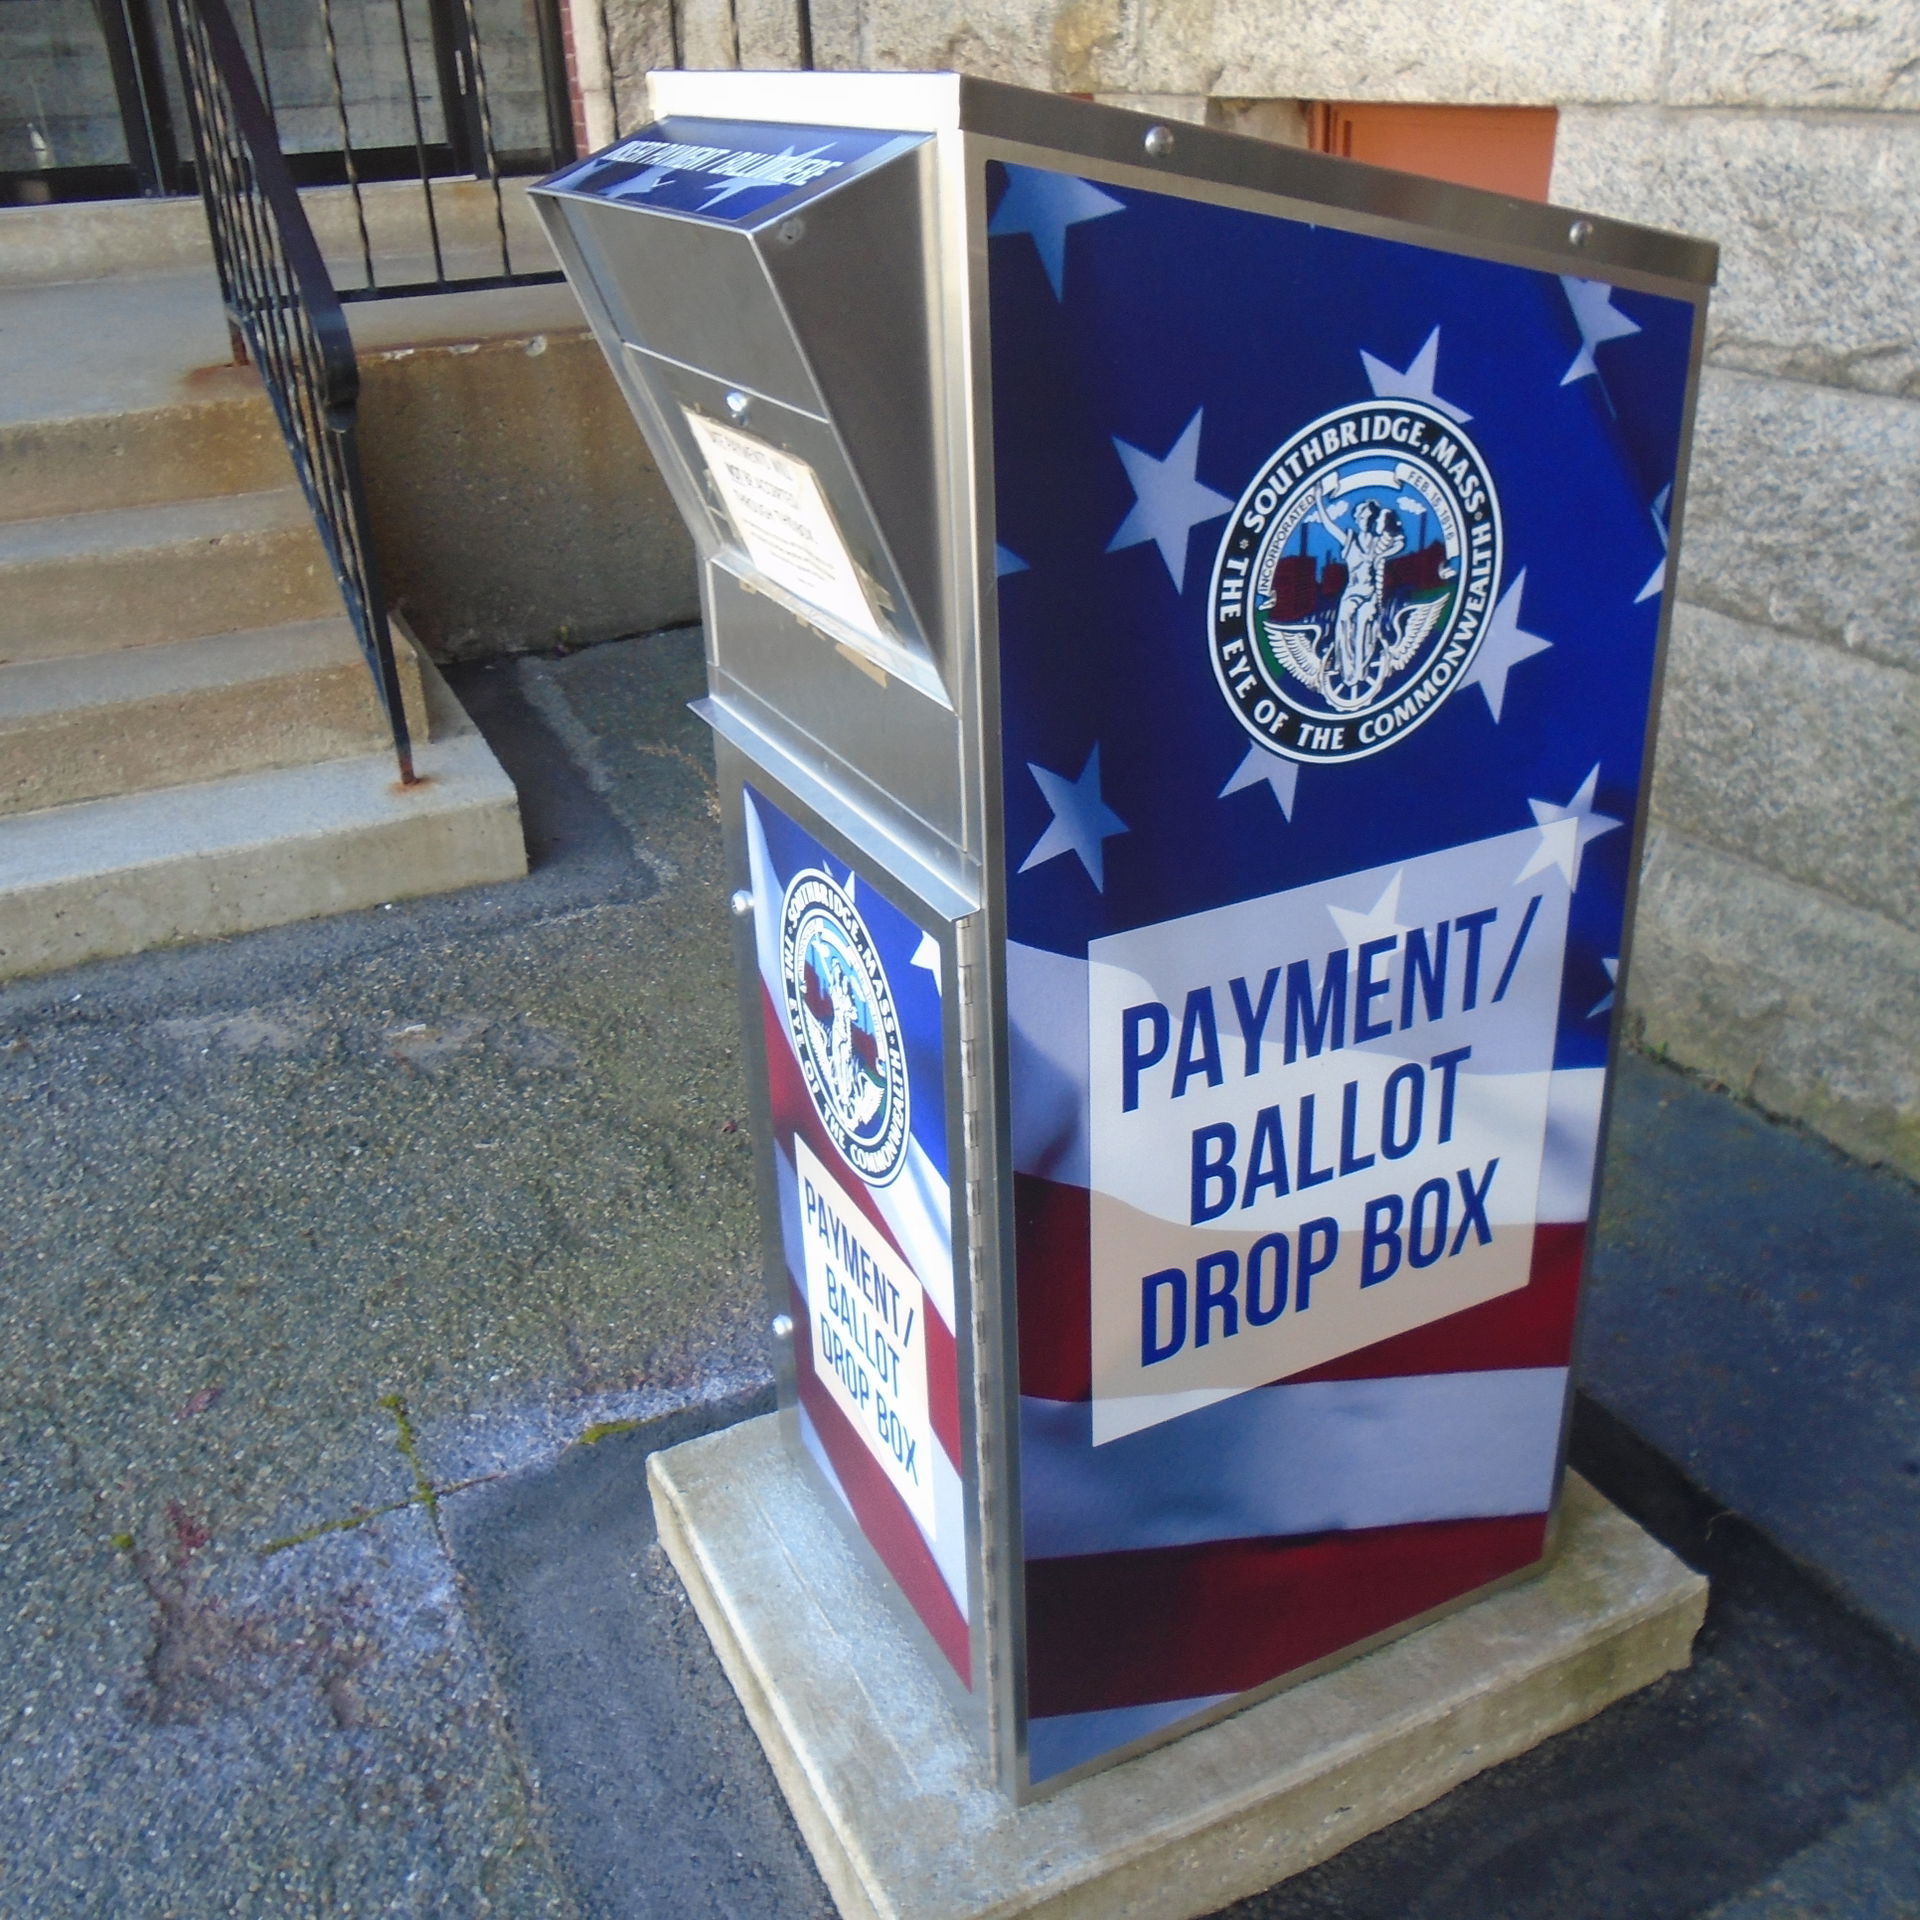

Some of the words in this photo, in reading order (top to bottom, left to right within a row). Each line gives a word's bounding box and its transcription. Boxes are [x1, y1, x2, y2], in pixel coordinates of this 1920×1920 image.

[1431, 436, 1486, 515] MASS
[1219, 557, 1249, 622] THE
[1259, 493, 1316, 592] INCORPORATED
[1222, 638, 1257, 699] EYE
[1357, 521, 1492, 745] COMMONWEALTH
[1254, 699, 1289, 735] OF
[1297, 722, 1346, 750] THE
[1121, 894, 1543, 1113] PAYMENT/
[823, 1103, 846, 1149] THE
[1190, 1046, 1471, 1226] BALLOT
[1141, 1216, 1338, 1367] DROP
[1360, 1157, 1500, 1289] BOX
[825, 1262, 900, 1399] BALLOT
[819, 1311, 870, 1410] DROP
[876, 1388, 919, 1487] BOX
